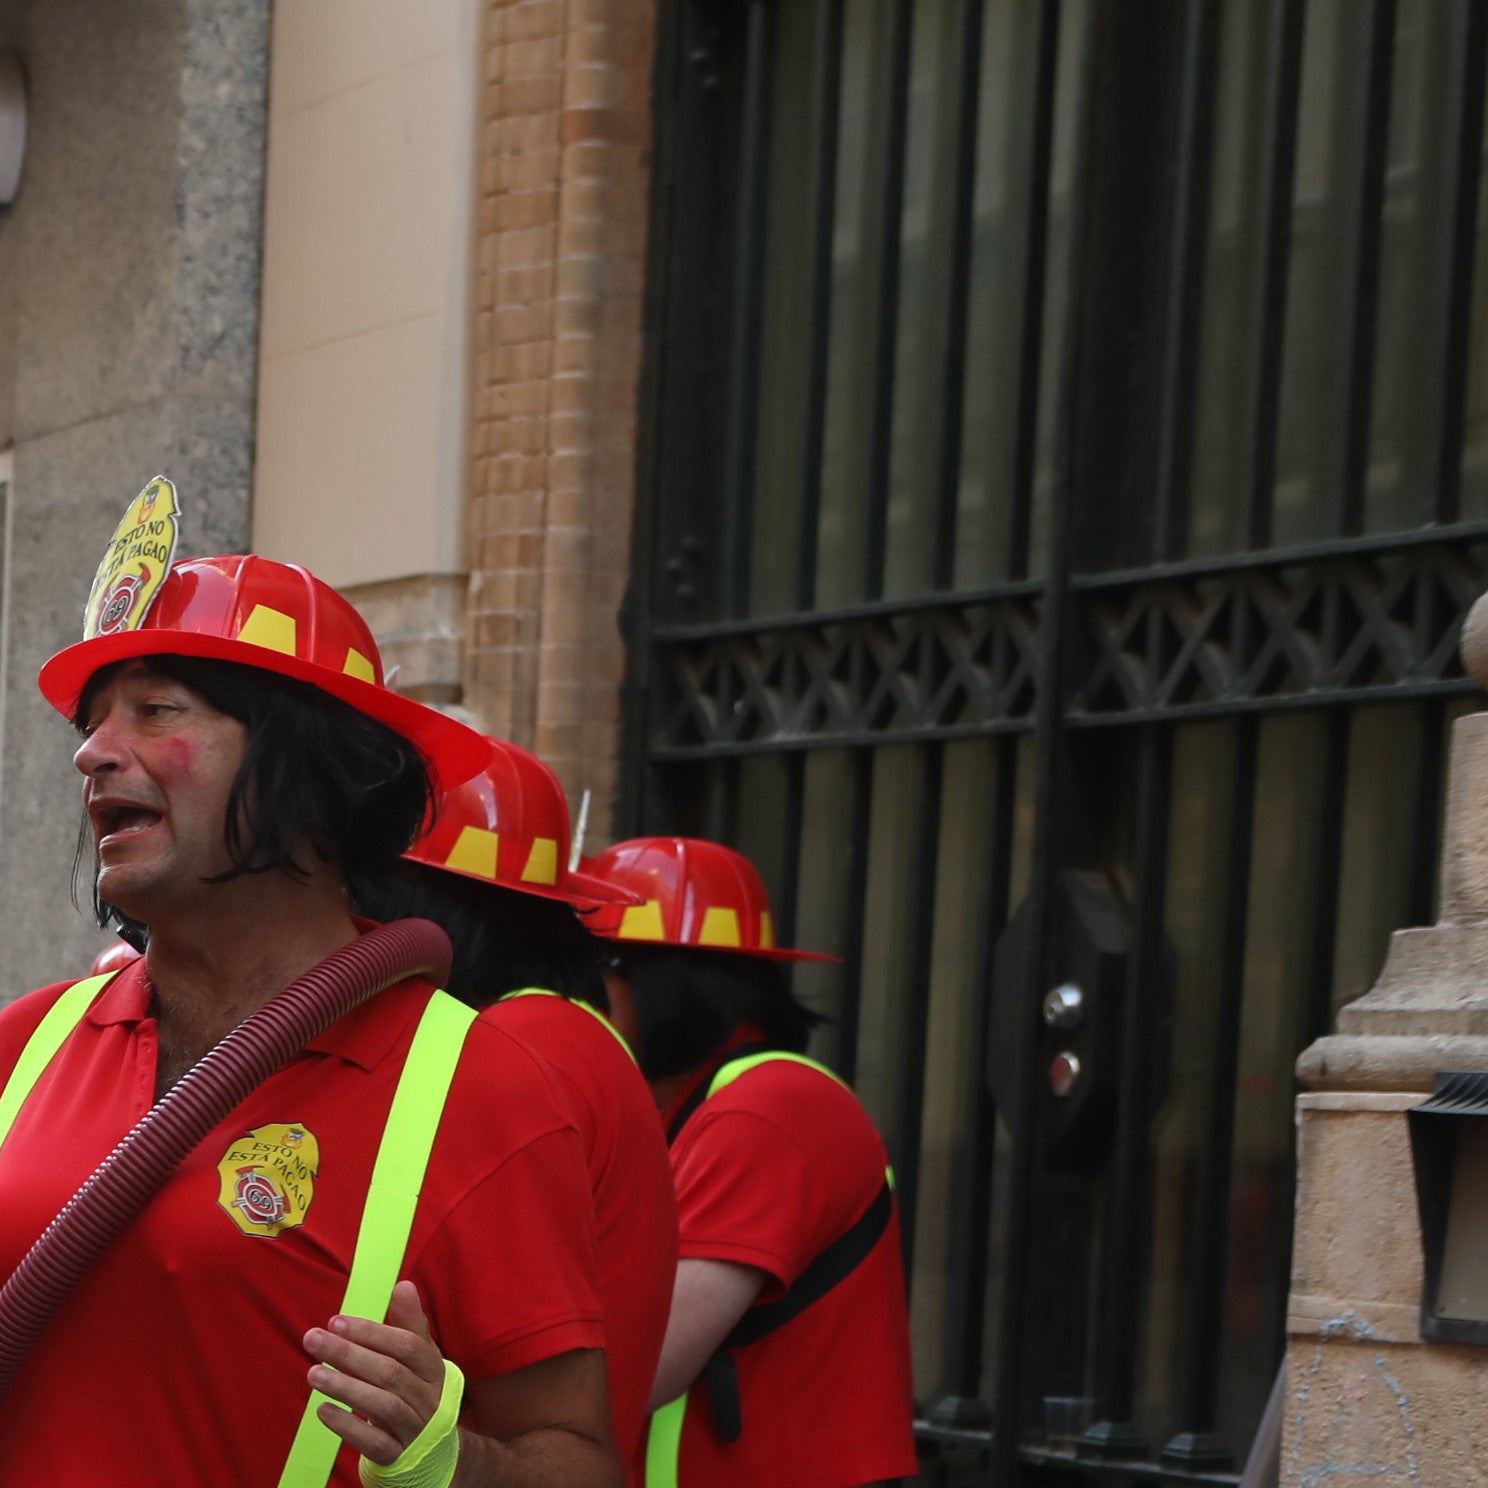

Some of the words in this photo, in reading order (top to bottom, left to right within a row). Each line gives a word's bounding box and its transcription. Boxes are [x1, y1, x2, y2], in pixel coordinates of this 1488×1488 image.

[113, 524, 146, 555] ESTO
[145, 520, 165, 536] NO
[128, 540, 168, 563] PAGAO
[103, 595, 129, 625] 69
[252, 1142, 292, 1157] ESTO
[293, 1156, 308, 1180] NO
[227, 1151, 271, 1162] ESTÁ
[272, 1157, 306, 1211] PAGAO
[249, 1189, 272, 1210] 69
